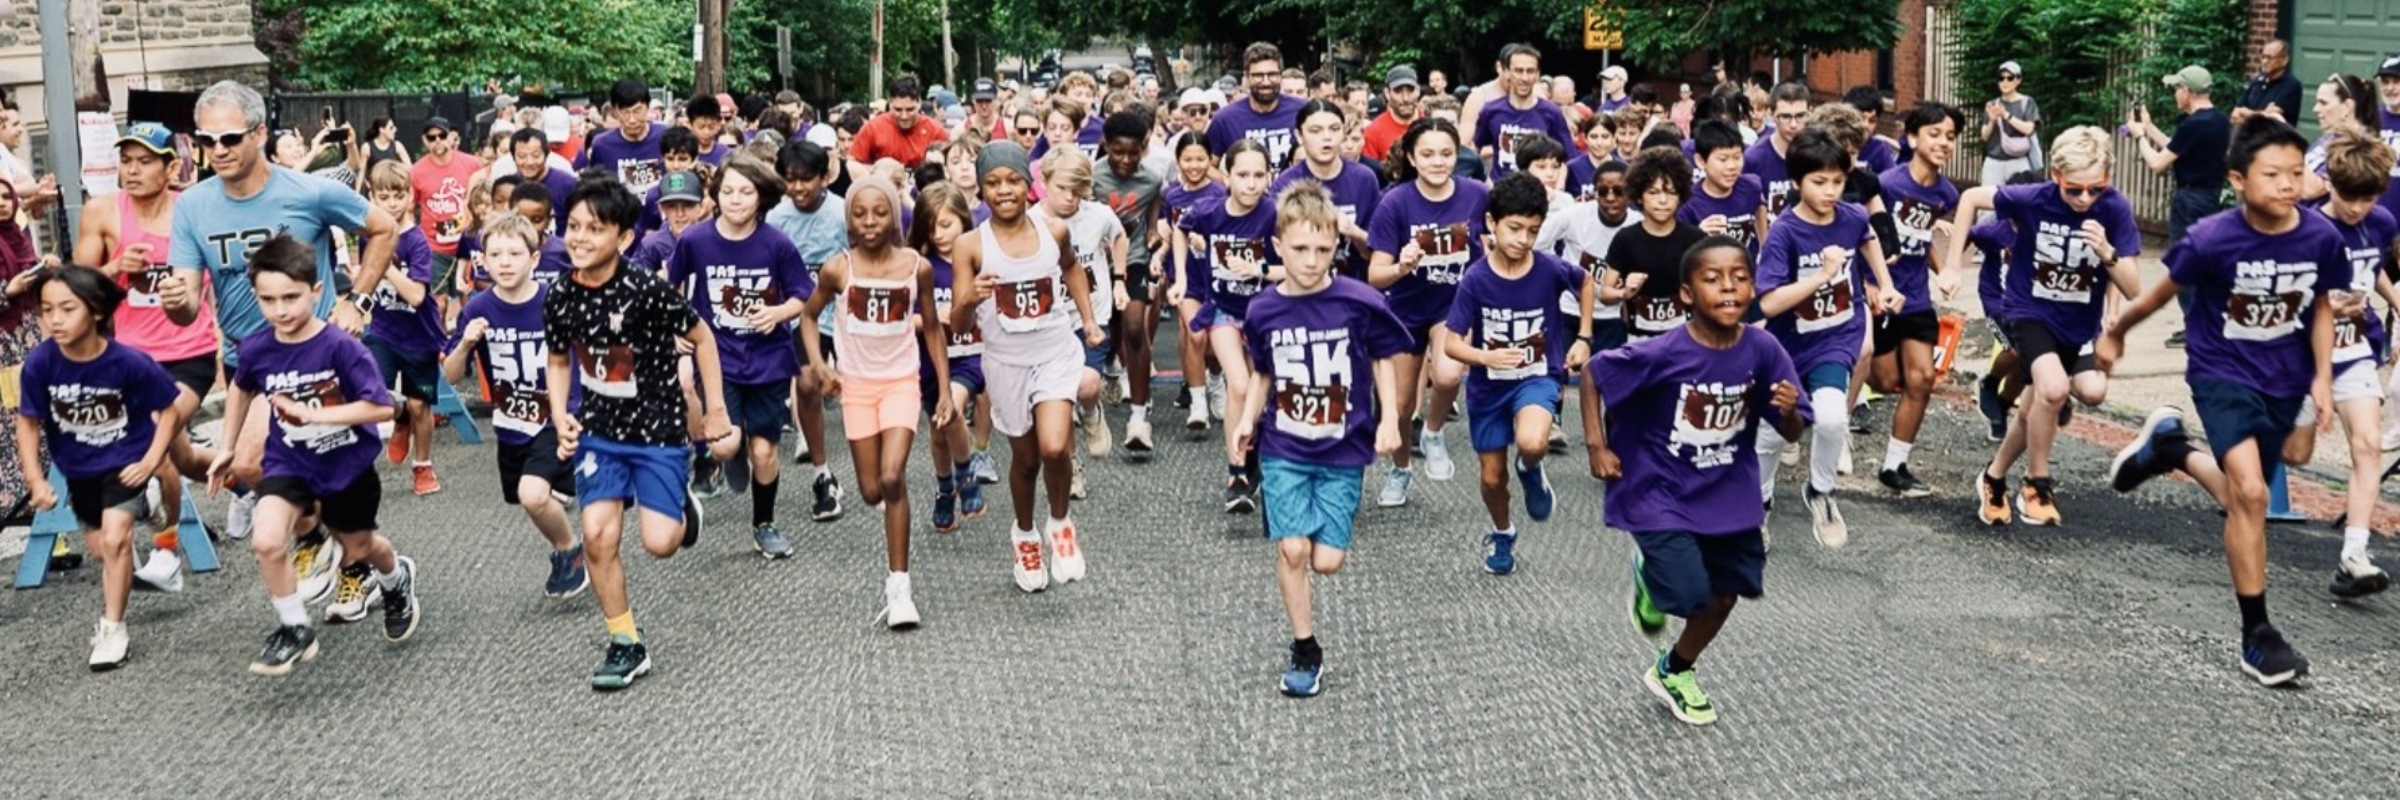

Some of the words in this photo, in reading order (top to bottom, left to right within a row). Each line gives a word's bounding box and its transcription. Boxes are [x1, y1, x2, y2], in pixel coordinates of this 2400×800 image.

[2040, 221, 2070, 236] PAS
[1434, 233, 1452, 255] 11
[706, 265, 736, 278] PAS
[2236, 260, 2276, 278] PAS
[2046, 271, 2081, 291] 342
[934, 288, 953, 301] PA
[1016, 291, 1040, 316] 95
[866, 298, 890, 322] 81
[1482, 306, 1512, 321] PAS
[1647, 303, 1676, 320] 166
[1814, 295, 1837, 318] 94
[2244, 302, 2288, 327] 373
[485, 328, 517, 342] PAS
[1271, 327, 1307, 348] PAS
[595, 356, 607, 381] 6
[1273, 338, 1353, 388] 5K
[67, 404, 109, 425] 220
[505, 397, 540, 425] 233
[1291, 394, 1331, 424] 321
